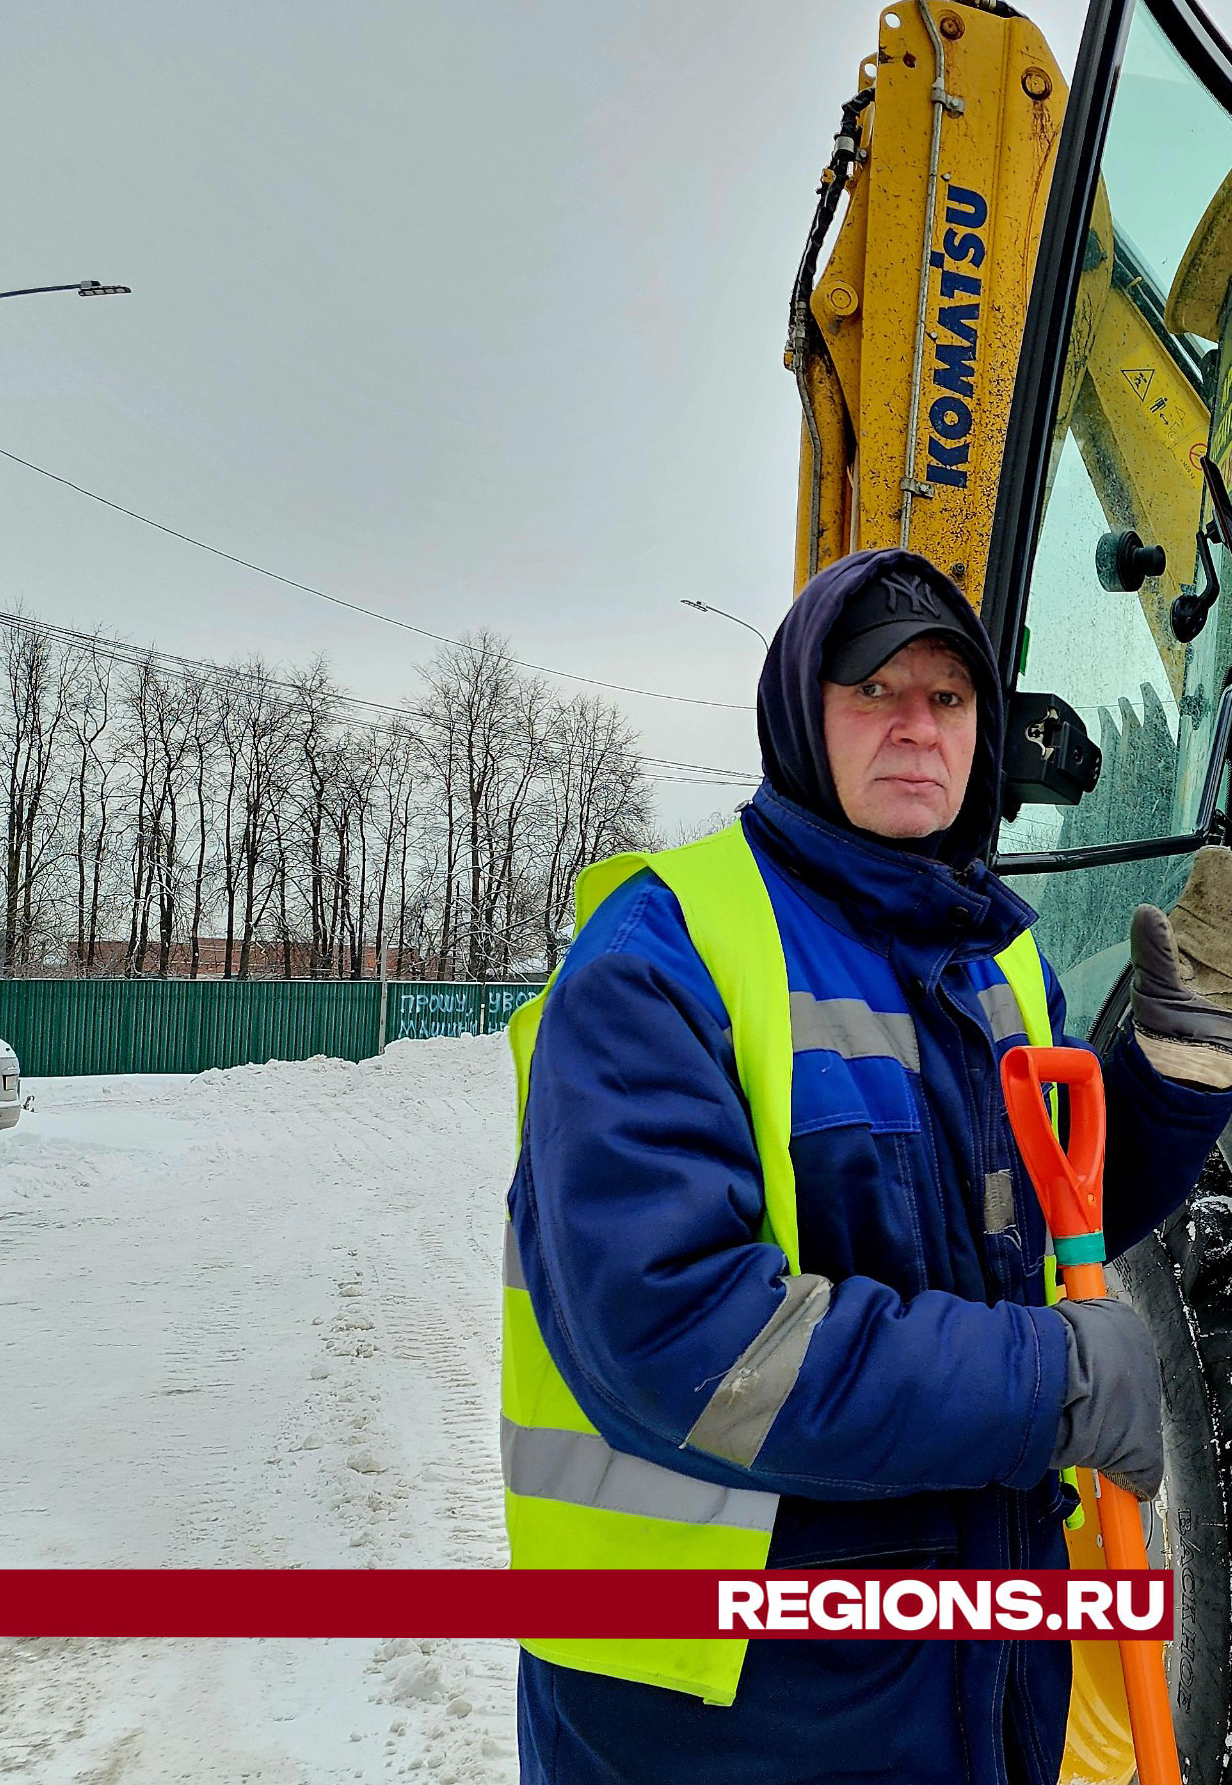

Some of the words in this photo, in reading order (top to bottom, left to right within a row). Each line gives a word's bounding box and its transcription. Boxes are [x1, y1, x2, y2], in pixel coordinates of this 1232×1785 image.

[925, 184, 988, 489] KOMATSU
[881, 572, 941, 618] NY
[400, 993, 474, 1017] ПРОШУ,
[1177, 1508, 1197, 1714] BACKHOE
